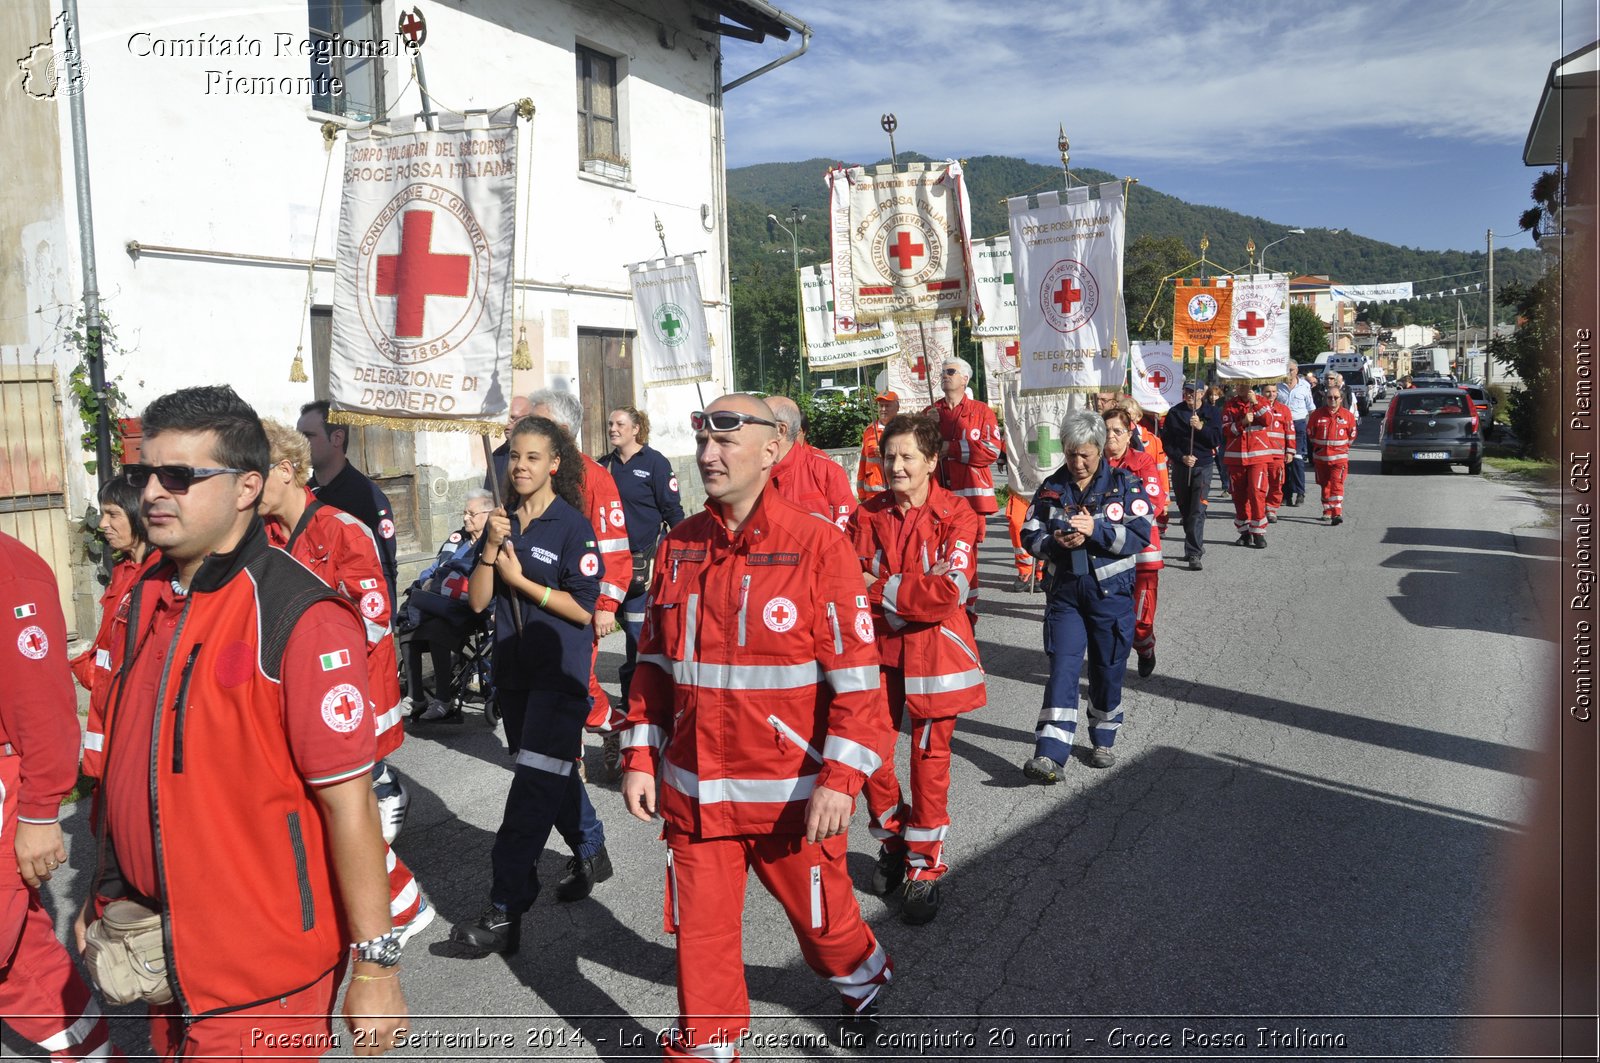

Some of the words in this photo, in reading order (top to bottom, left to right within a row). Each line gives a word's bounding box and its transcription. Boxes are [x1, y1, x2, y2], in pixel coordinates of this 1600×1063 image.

[352, 147, 383, 162] CORPO
[386, 141, 429, 162] VOLONTARI
[435, 142, 456, 157] DEL
[459, 137, 507, 156] SOCCORSO
[345, 166, 393, 184] CROCE
[395, 162, 444, 181] ROSSA
[449, 159, 513, 179] ITALIANA
[361, 185, 424, 257] CONVENZIONE
[429, 188, 445, 203] DI
[448, 197, 487, 256] GINEVRA
[836, 206, 850, 247] ITALIANA
[855, 208, 881, 242] CROCE
[879, 196, 914, 213] ROSSA
[916, 199, 954, 239] ITALIANA
[1022, 223, 1049, 237] CROCE
[1051, 220, 1074, 232] ROSSA
[1075, 215, 1110, 229] ITALIANA
[874, 234, 901, 285] CONVENZIONE
[892, 215, 926, 229] GINEVRA
[838, 251, 852, 279] ROSSA
[839, 283, 853, 312] CROCE
[859, 294, 905, 305] COMITATO
[906, 294, 916, 305] DI
[974, 325, 1017, 333] VOLONTARI
[810, 351, 857, 362] DELEGAZIONE
[1033, 348, 1096, 362] DELEGAZIONE
[1052, 361, 1085, 373] BARGE
[354, 366, 454, 390] DELEGAZIONE
[461, 376, 478, 392] DI
[360, 388, 456, 413] DRONERO
